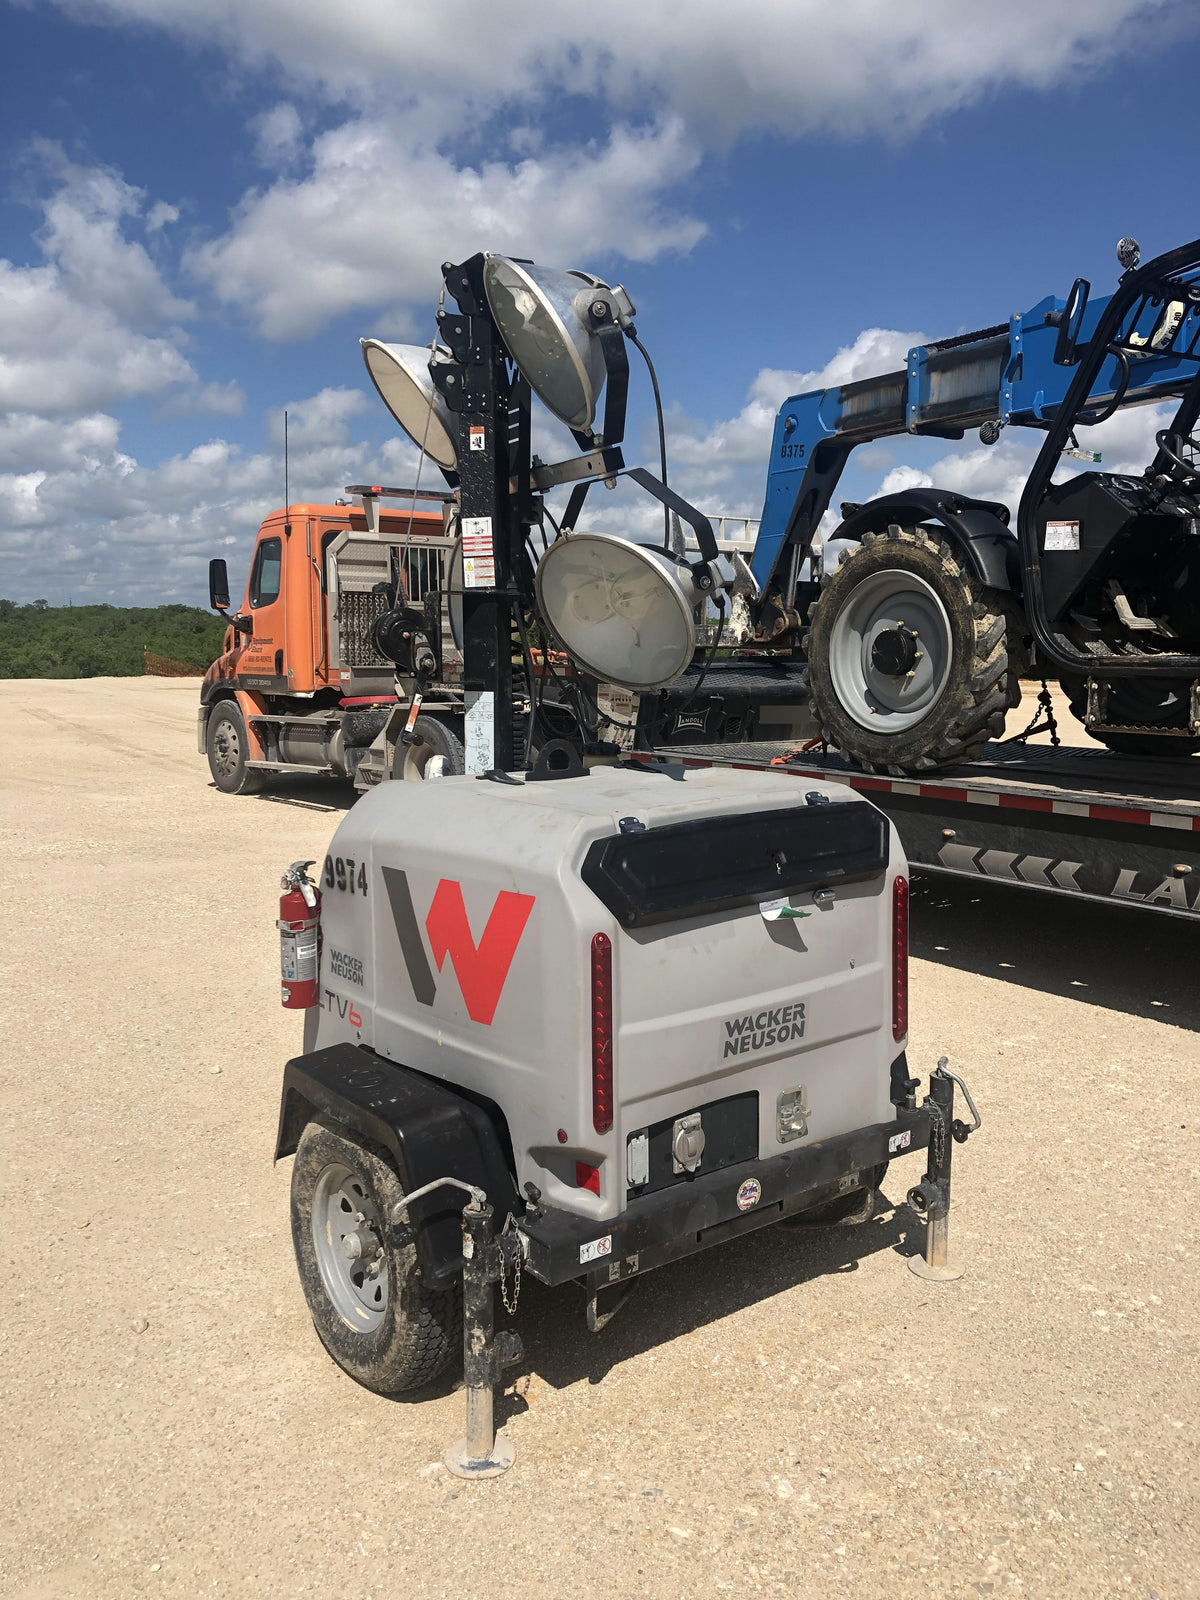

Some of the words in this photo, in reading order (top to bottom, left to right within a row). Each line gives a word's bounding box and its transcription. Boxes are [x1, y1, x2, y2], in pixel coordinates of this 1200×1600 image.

[324, 854, 368, 897] 9974
[330, 948, 364, 974] WACKER
[330, 963, 364, 987] NEUSON
[318, 989, 363, 1029] TV6
[725, 1002, 806, 1038] WACKER
[723, 1020, 806, 1059] NEUSON
